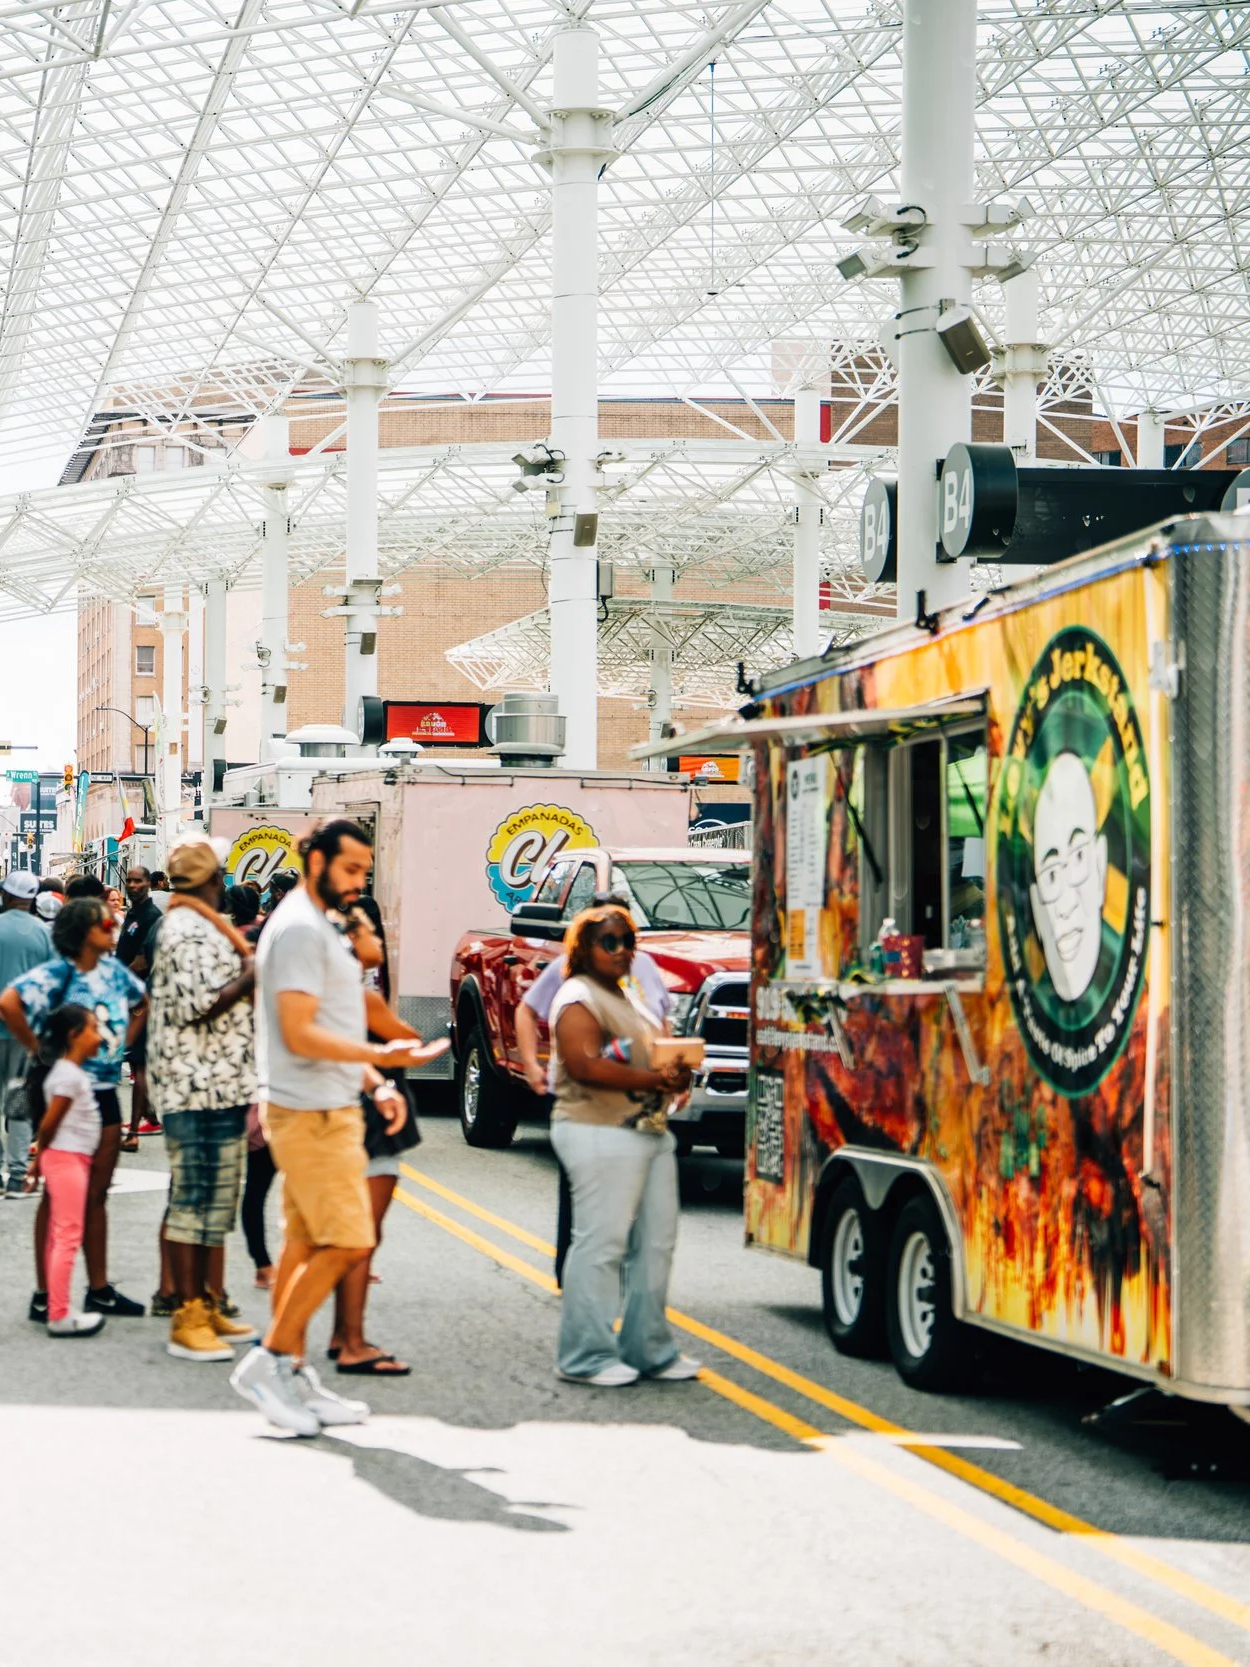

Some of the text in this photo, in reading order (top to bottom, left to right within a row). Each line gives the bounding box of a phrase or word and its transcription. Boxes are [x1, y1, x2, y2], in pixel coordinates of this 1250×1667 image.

[943, 467, 972, 534] B4
[863, 499, 890, 562] B4
[1051, 641, 1149, 812] Jerkstand
[10, 771, 33, 779] Wrenn
[23, 820, 55, 829] SUTES
[238, 832, 292, 852] EMPANADA
[506, 812, 584, 836] EMPANADAS
[1064, 1046, 1097, 1073] Spice
[1095, 1023, 1116, 1054] To
[1111, 955, 1139, 1026] Your
[1130, 886, 1147, 957] Life
